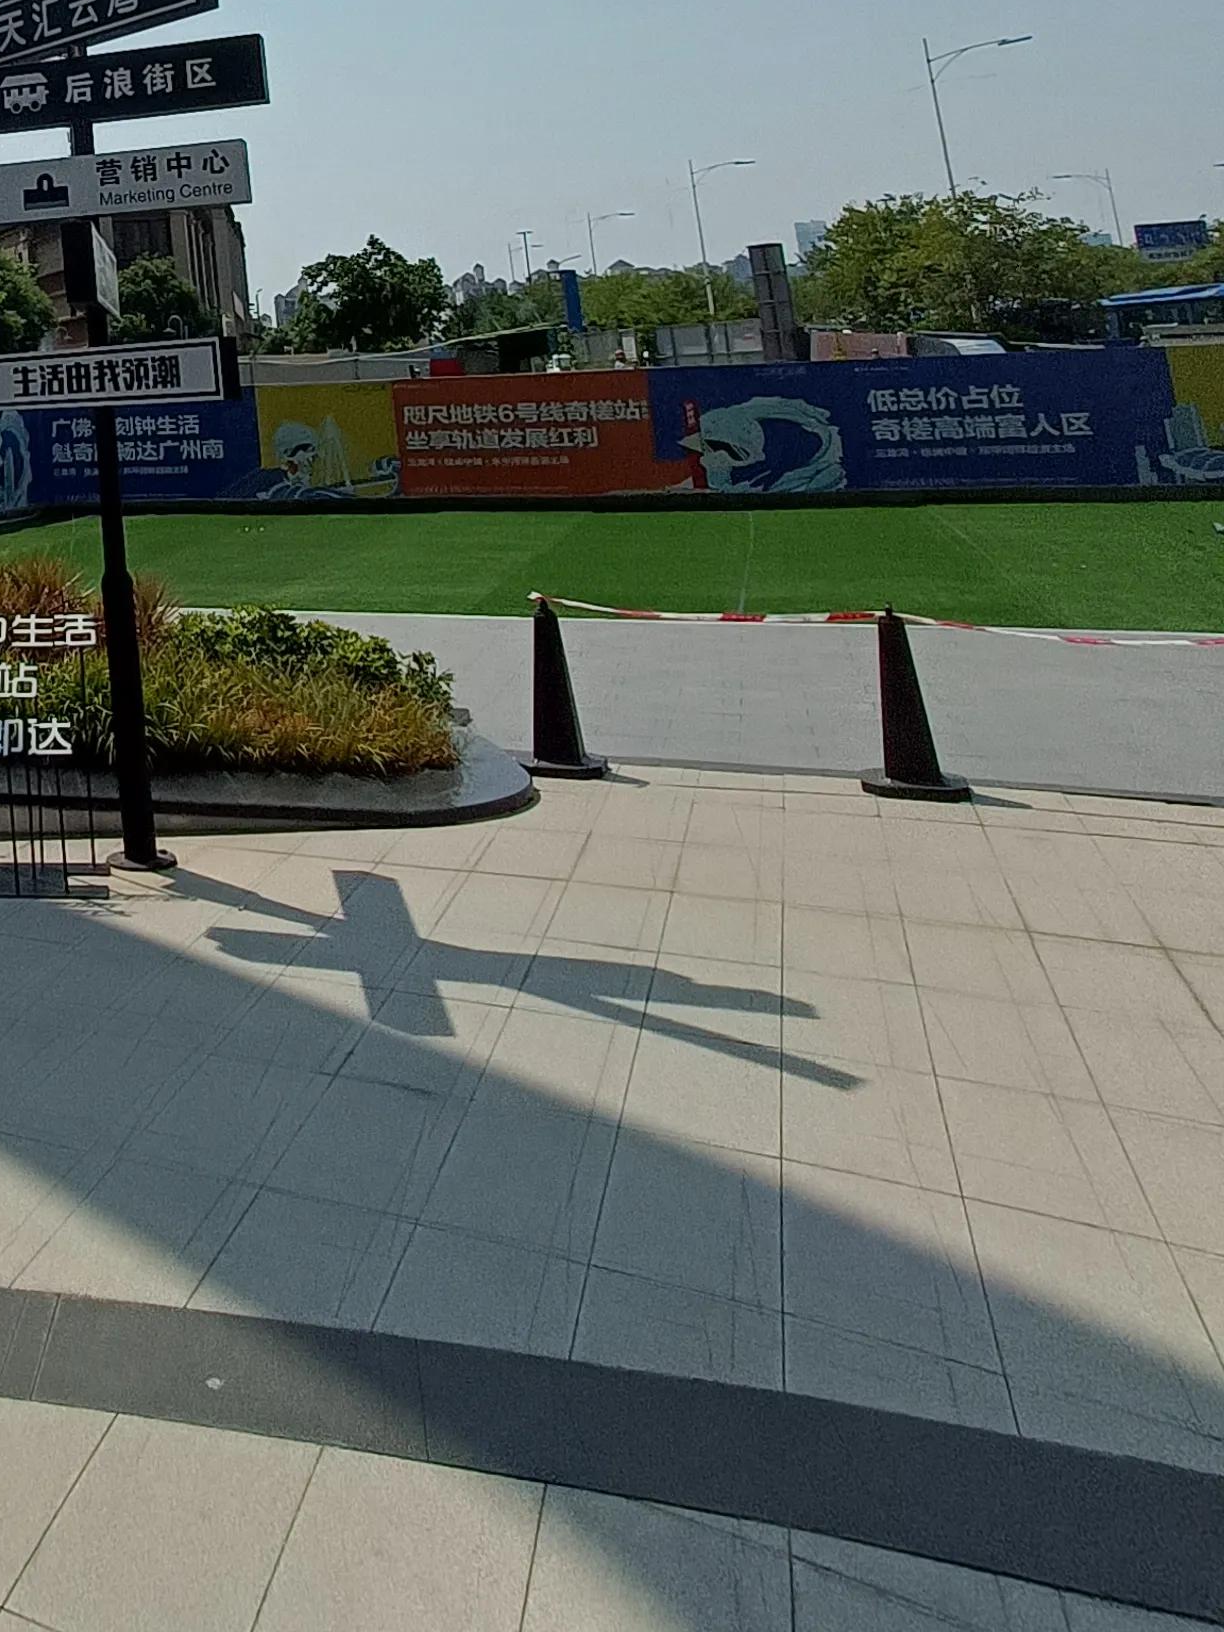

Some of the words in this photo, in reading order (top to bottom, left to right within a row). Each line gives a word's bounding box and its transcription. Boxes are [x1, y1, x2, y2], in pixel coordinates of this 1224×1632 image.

[64, 57, 216, 103] 后浪街区
[96, 149, 230, 186] 营销中心
[99, 187, 175, 207] Marketing
[179, 180, 233, 198] Centre
[13, 355, 182, 397] 生活由我领潮
[867, 384, 1024, 412] 低总价占位
[52, 414, 200, 438] 广佛刻钟生活
[406, 426, 599, 451] 坐享轨道发展红利
[871, 413, 1094, 441] 奇槎高端富人区
[52, 439, 224, 463] 魁奇畅达广州南
